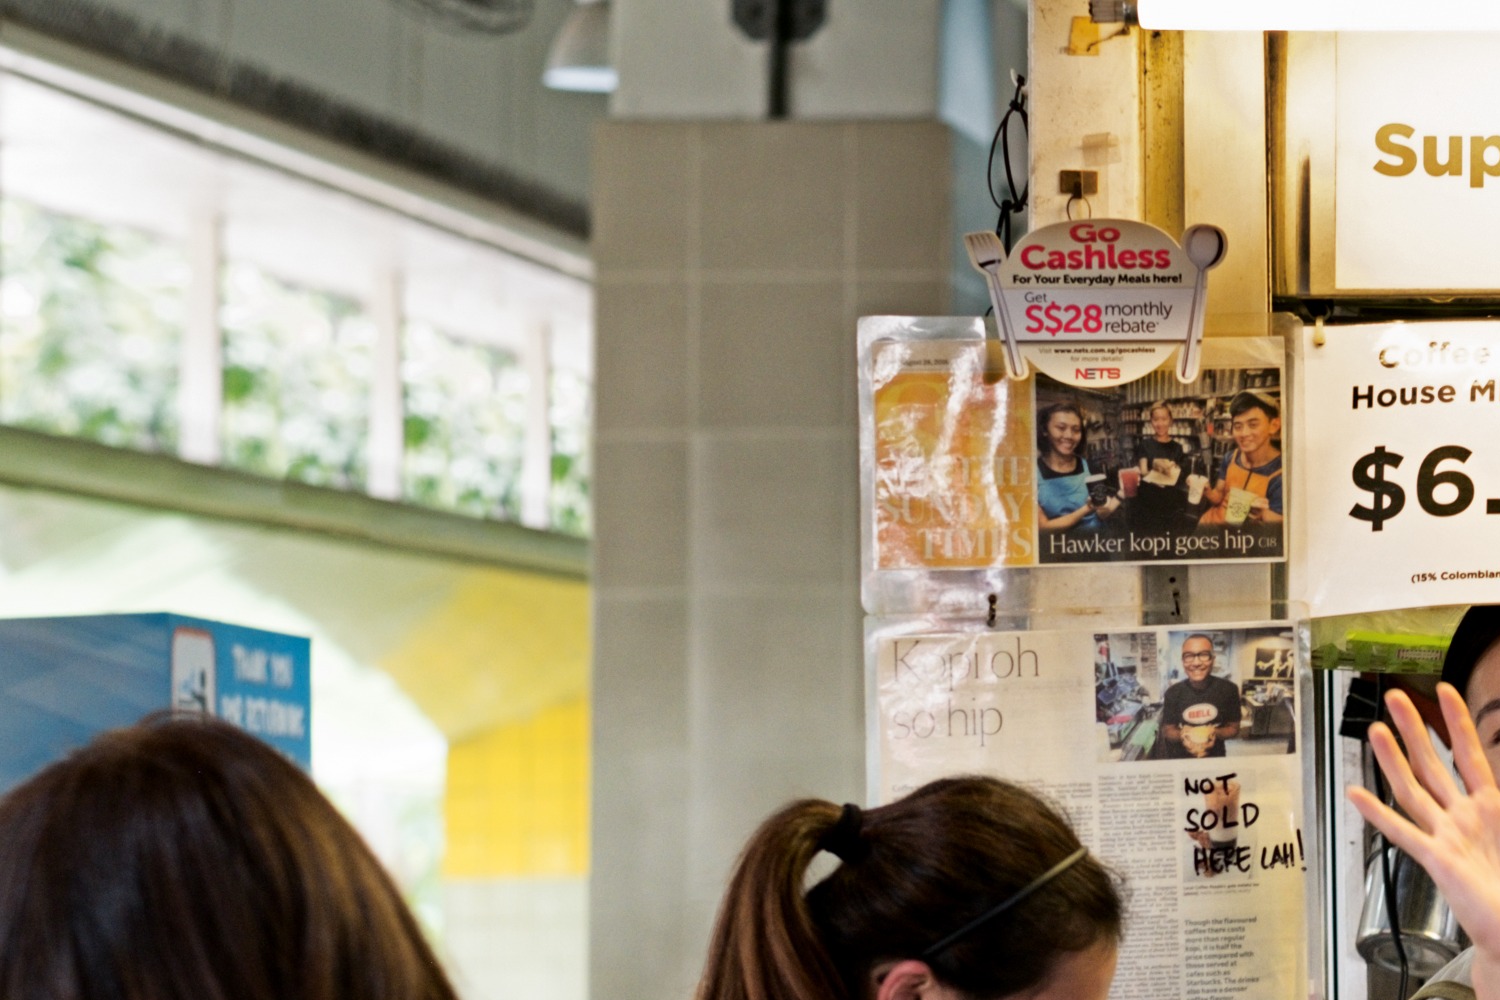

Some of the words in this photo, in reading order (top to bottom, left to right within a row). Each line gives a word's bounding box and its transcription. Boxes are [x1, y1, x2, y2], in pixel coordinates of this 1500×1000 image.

[1069, 223, 1120, 243] Go
[1020, 244, 1171, 271] Cashless
[1013, 275, 1032, 285] For
[1034, 275, 1061, 286] Your
[1063, 273, 1116, 287] Everyday
[1118, 273, 1151, 285] Meals
[1152, 273, 1183, 285] here!
[1024, 290, 1047, 304] Get
[1024, 303, 1103, 337] S$28
[1104, 300, 1173, 322] monthly
[1378, 341, 1491, 368] Coffee
[1075, 368, 1121, 380] NETS
[1351, 384, 1456, 410] House
[1050, 532, 1124, 554] Hawker
[1129, 529, 1171, 556] kopi
[1175, 534, 1220, 557] goes
[1224, 529, 1254, 555] hip
[1411, 571, 1437, 584] (15%
[893, 634, 981, 693] Kopi
[990, 637, 1040, 678] oh
[893, 710, 936, 739] so
[947, 697, 1004, 747] hip
[1184, 773, 1237, 796] NOT
[1184, 803, 1259, 834] SOLD
[1193, 843, 1252, 876] HERE
[1260, 829, 1308, 872] LAH!
